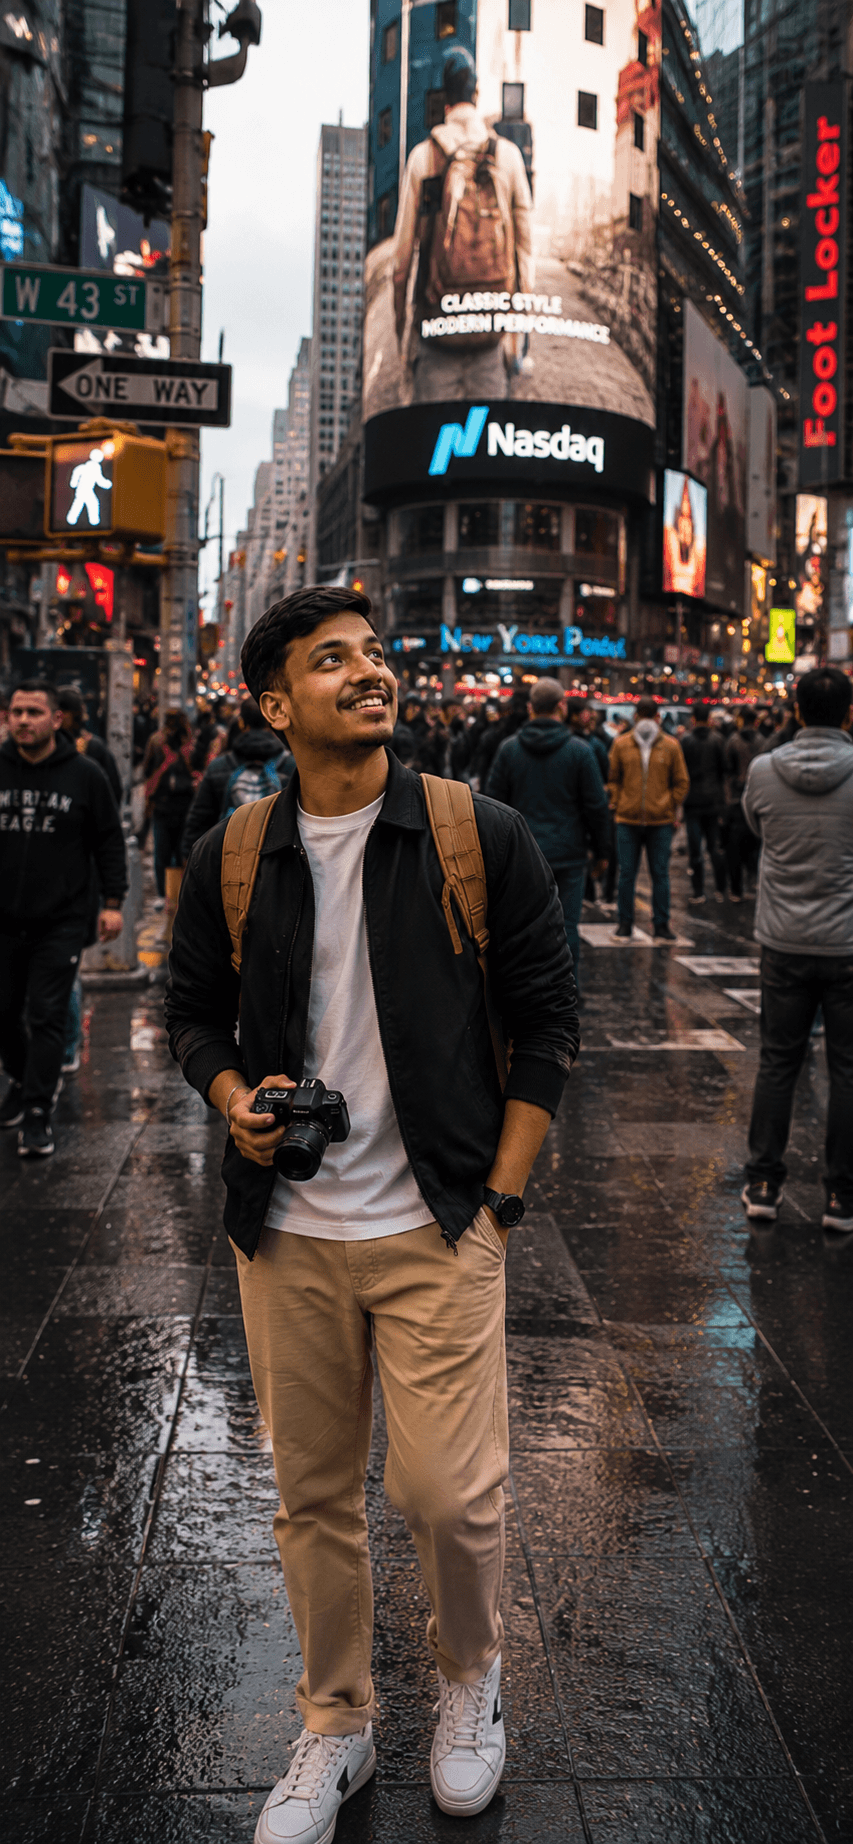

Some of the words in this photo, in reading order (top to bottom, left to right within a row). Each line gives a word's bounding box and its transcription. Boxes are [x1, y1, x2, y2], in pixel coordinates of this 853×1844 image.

[805, 115, 841, 301] Locker
[15, 275, 41, 313] W
[56, 281, 99, 320] 43
[113, 284, 139, 306] ST
[441, 292, 511, 314] CLASSIC
[512, 292, 562, 315] STYLE
[421, 313, 492, 338] MODERN
[493, 313, 611, 345] PERFORMANCE
[75, 373, 129, 400] ONE
[153, 379, 209, 405] WAY
[803, 321, 838, 447] Foot
[487, 422, 604, 473] Nasdaq
